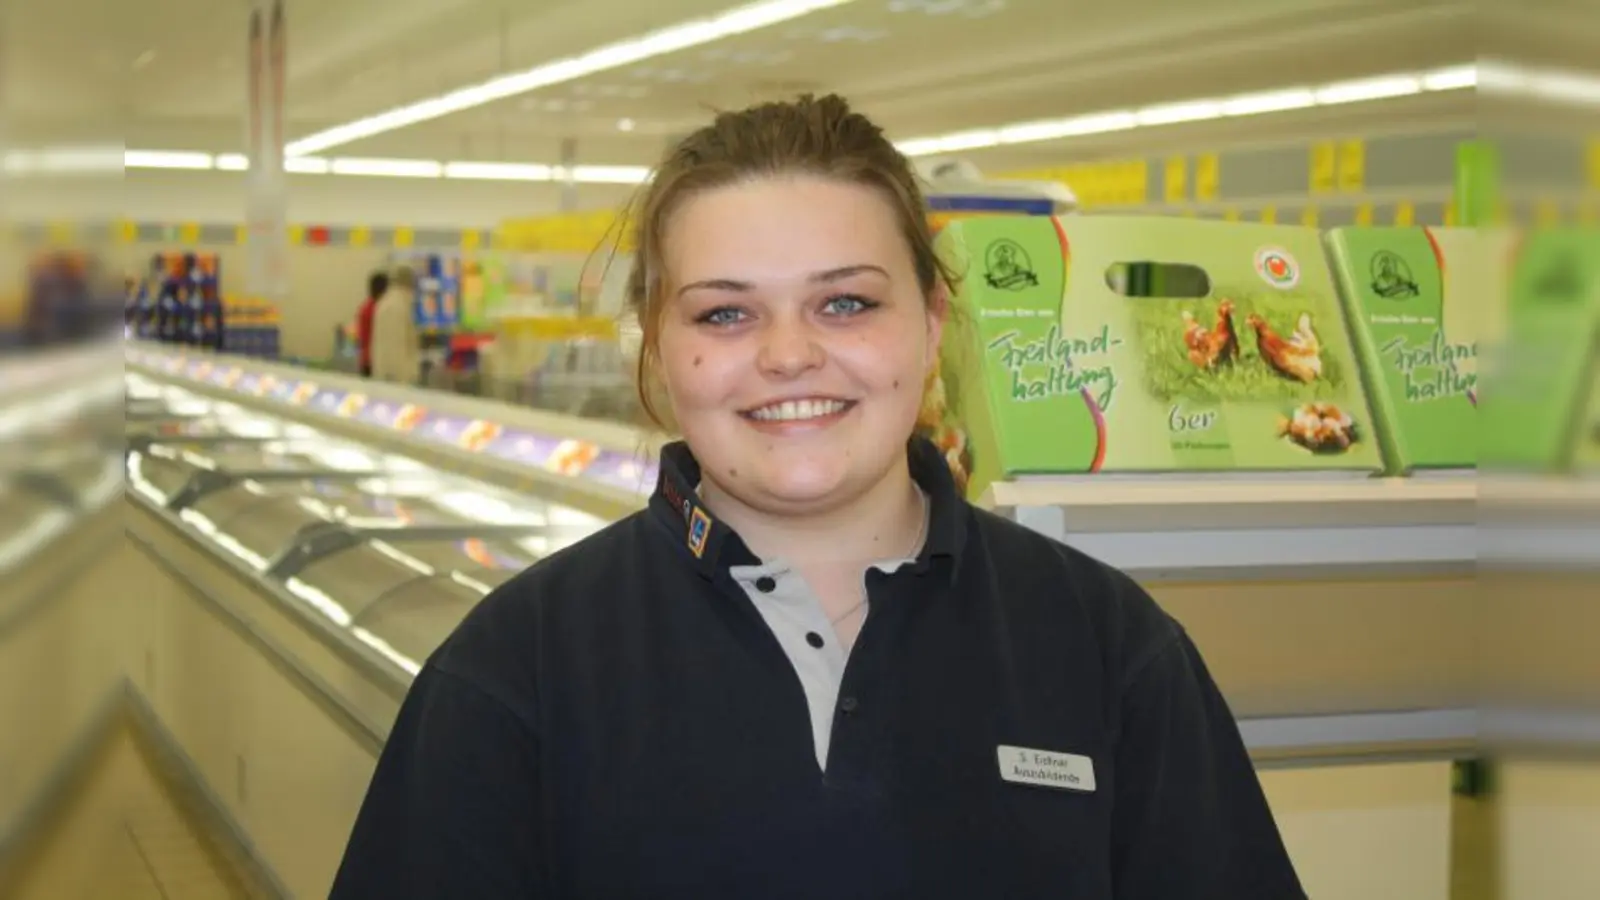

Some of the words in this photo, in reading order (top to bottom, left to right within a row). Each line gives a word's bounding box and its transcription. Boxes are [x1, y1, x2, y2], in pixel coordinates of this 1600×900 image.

[987, 323, 1122, 368] Freiland-
[1011, 363, 1118, 413] haltung
[1168, 403, 1216, 432] 6er
